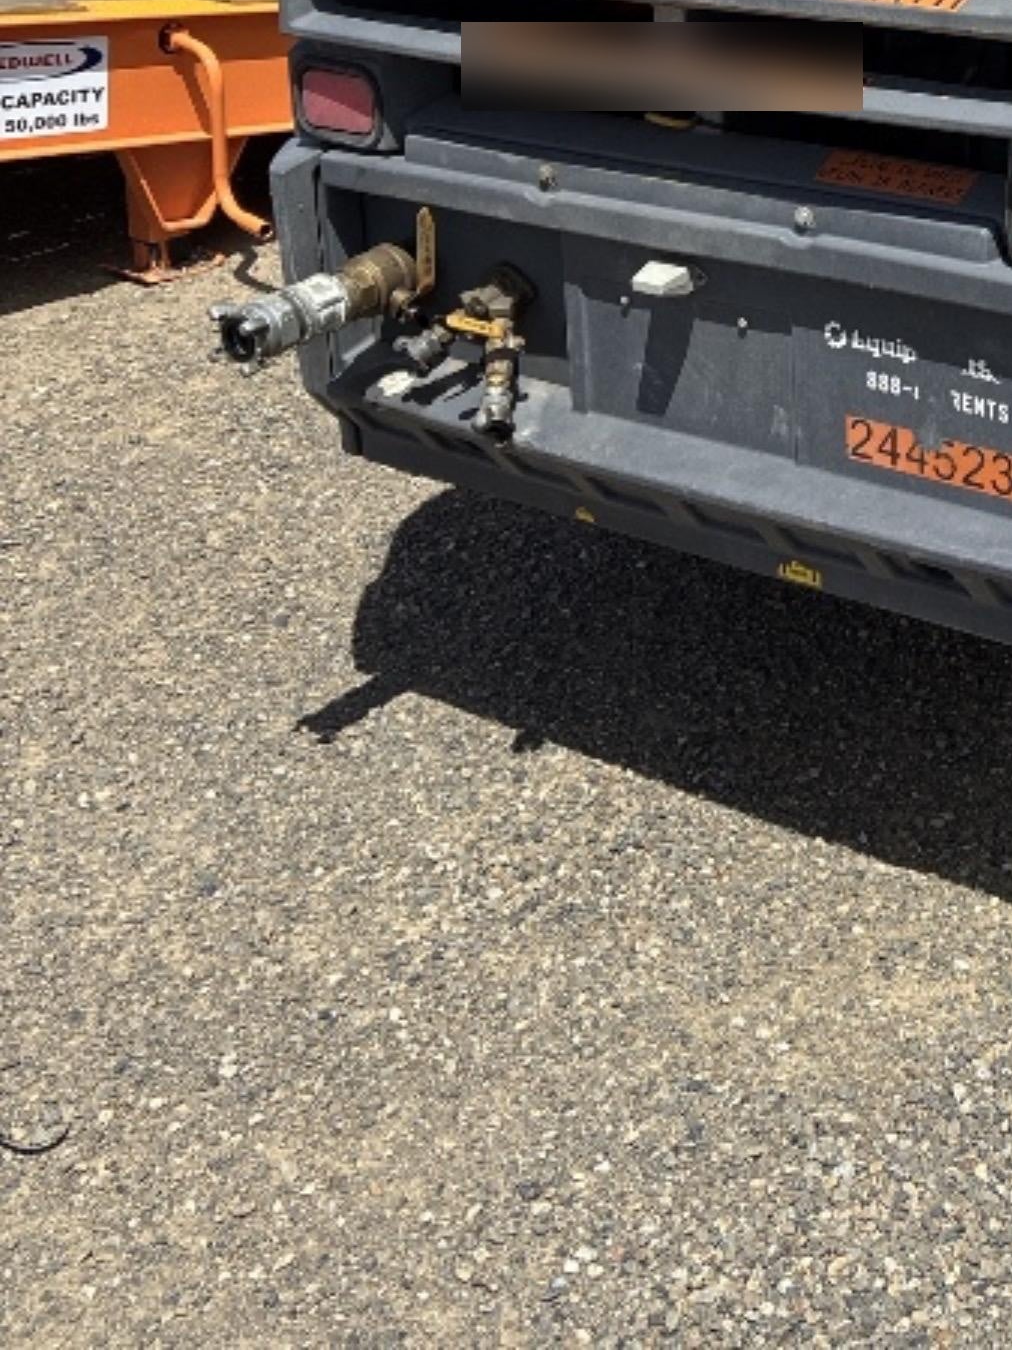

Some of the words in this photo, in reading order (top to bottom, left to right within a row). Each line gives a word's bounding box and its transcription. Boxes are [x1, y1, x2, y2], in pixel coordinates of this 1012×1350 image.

[1, 86, 105, 109] CAPACITY
[5, 113, 66, 132] 50,000
[74, 112, 99, 127] lbs
